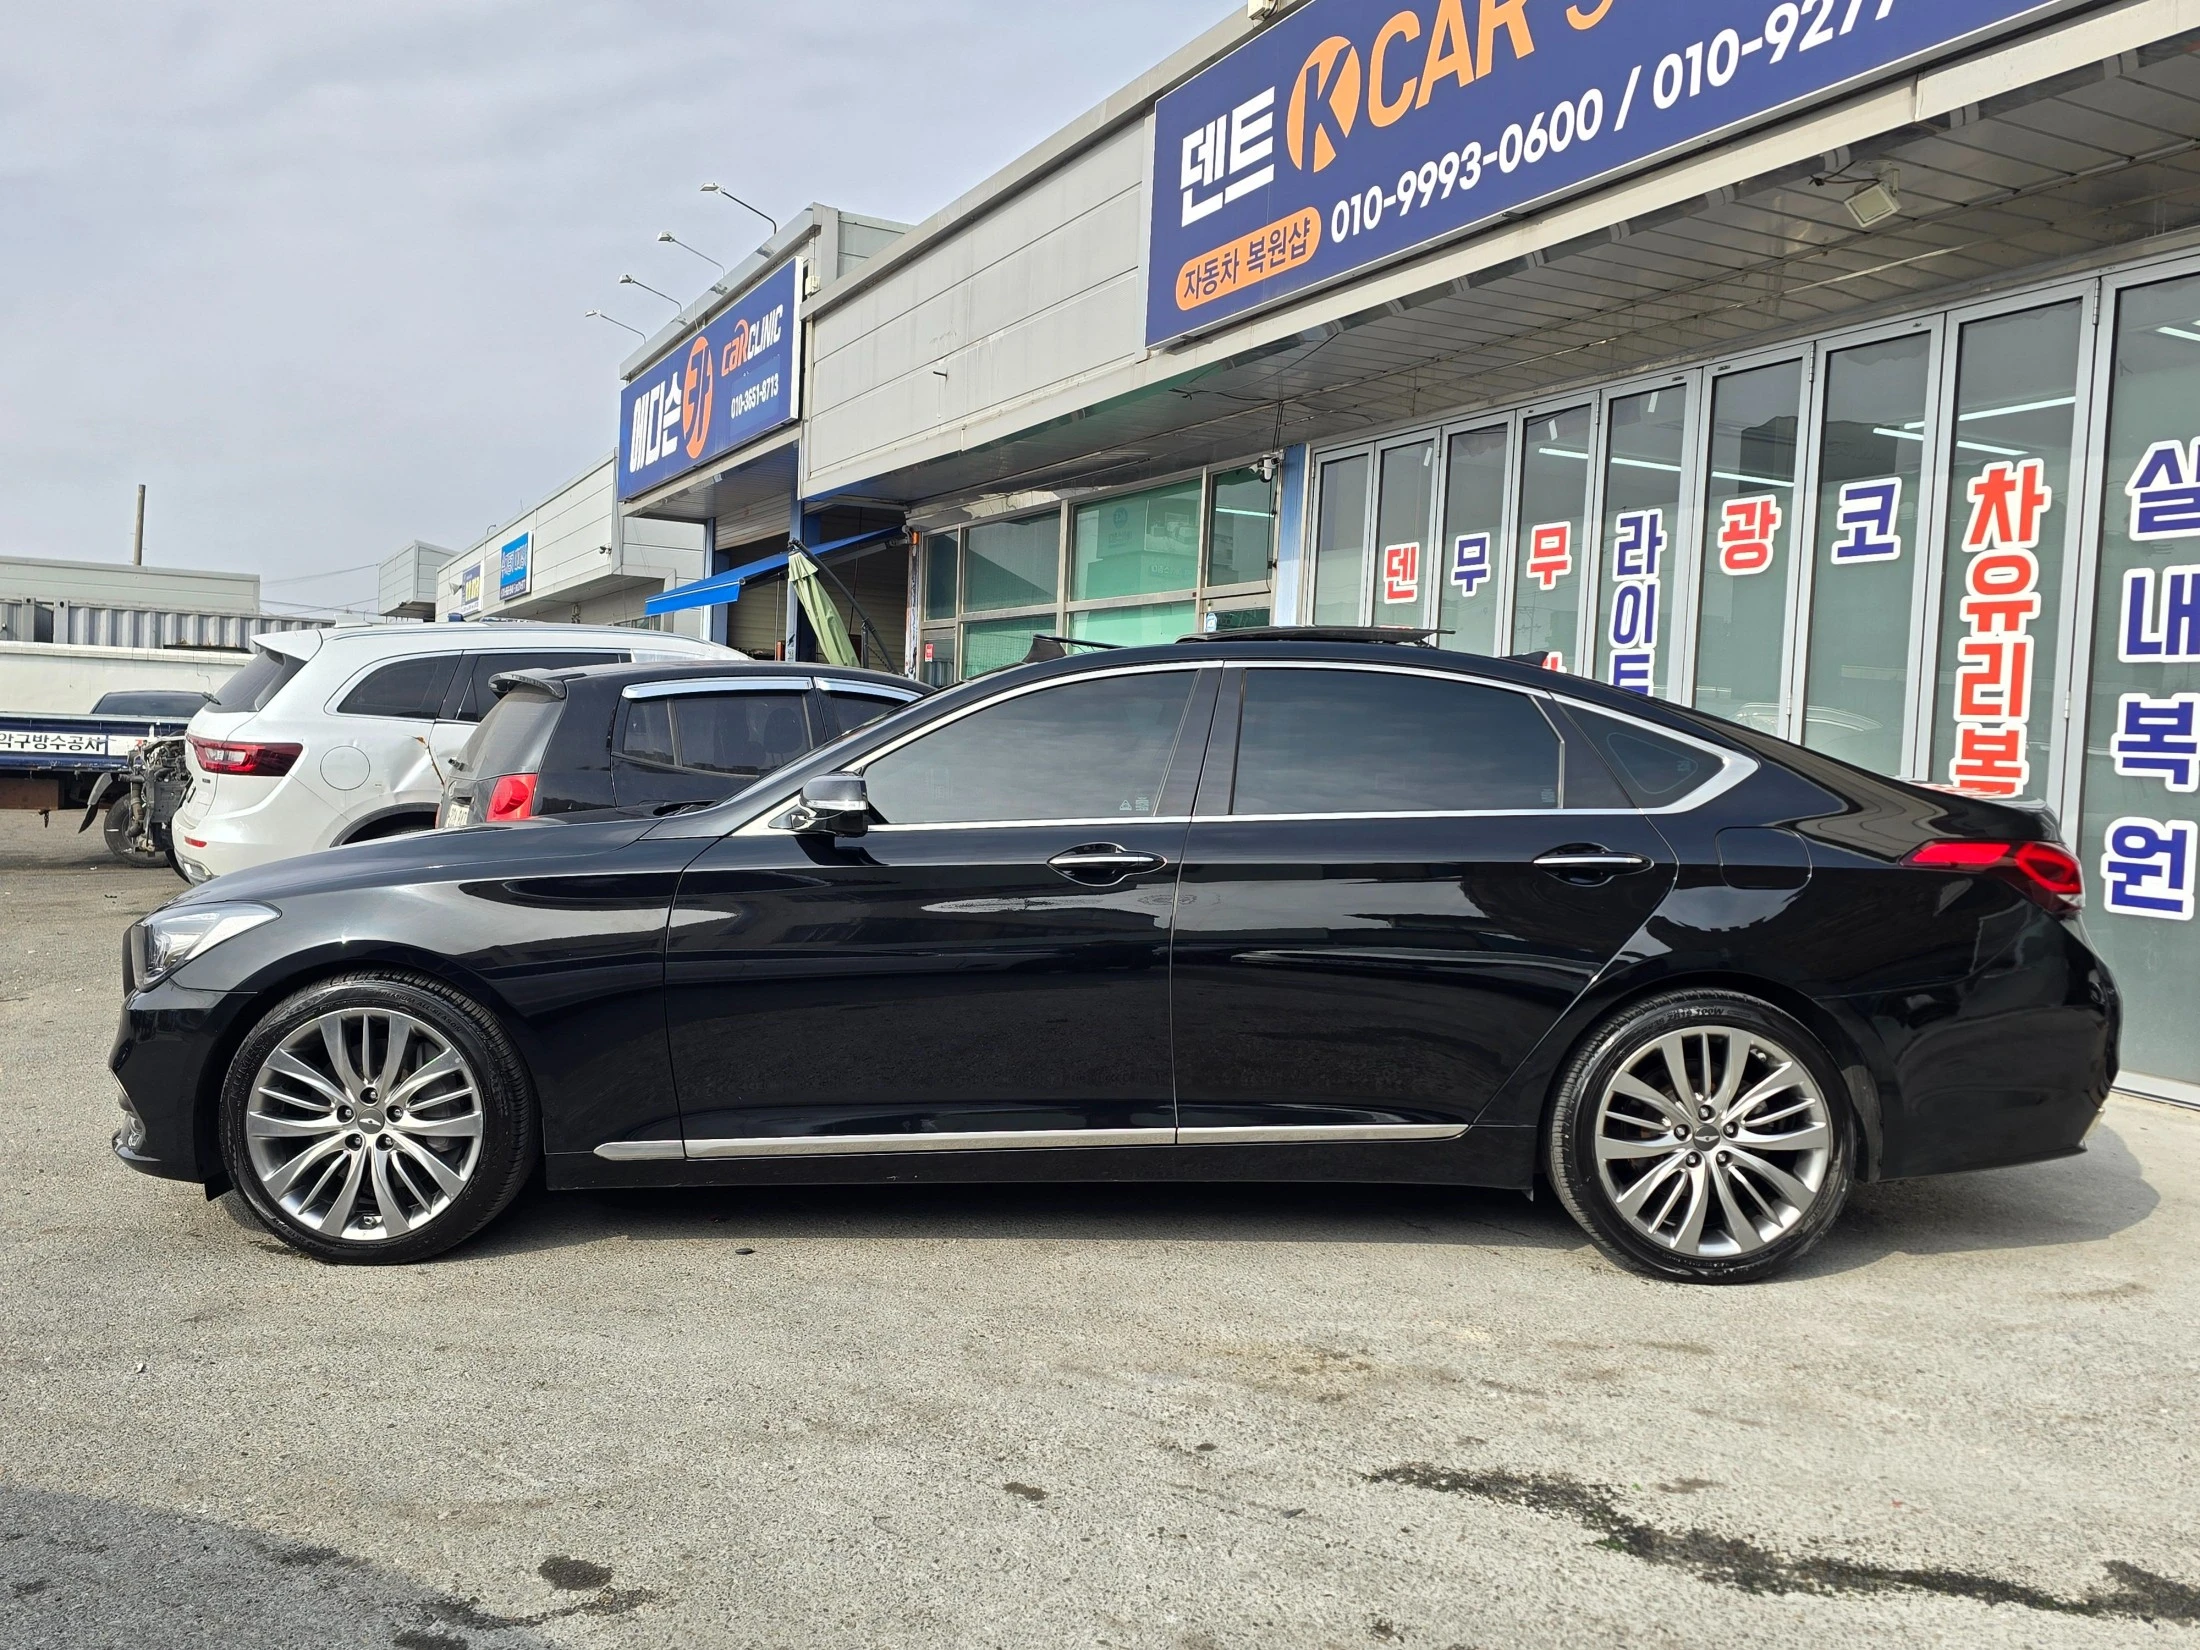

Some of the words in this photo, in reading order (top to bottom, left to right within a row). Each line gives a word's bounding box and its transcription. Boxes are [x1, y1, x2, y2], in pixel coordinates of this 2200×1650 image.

[1180, 86, 1275, 227] 덴트
[1331, 88, 1603, 243] 010-9993-0600
[1183, 248, 1239, 299] 자동차
[1246, 216, 1311, 274] 복원샵
[730, 372, 780, 420] 010-3651-8713
[1529, 524, 1569, 587] 무
[1720, 497, 1779, 573] 광
[1835, 480, 1899, 562] 코
[1385, 544, 1418, 602] 덴
[1453, 535, 1489, 594] 무
